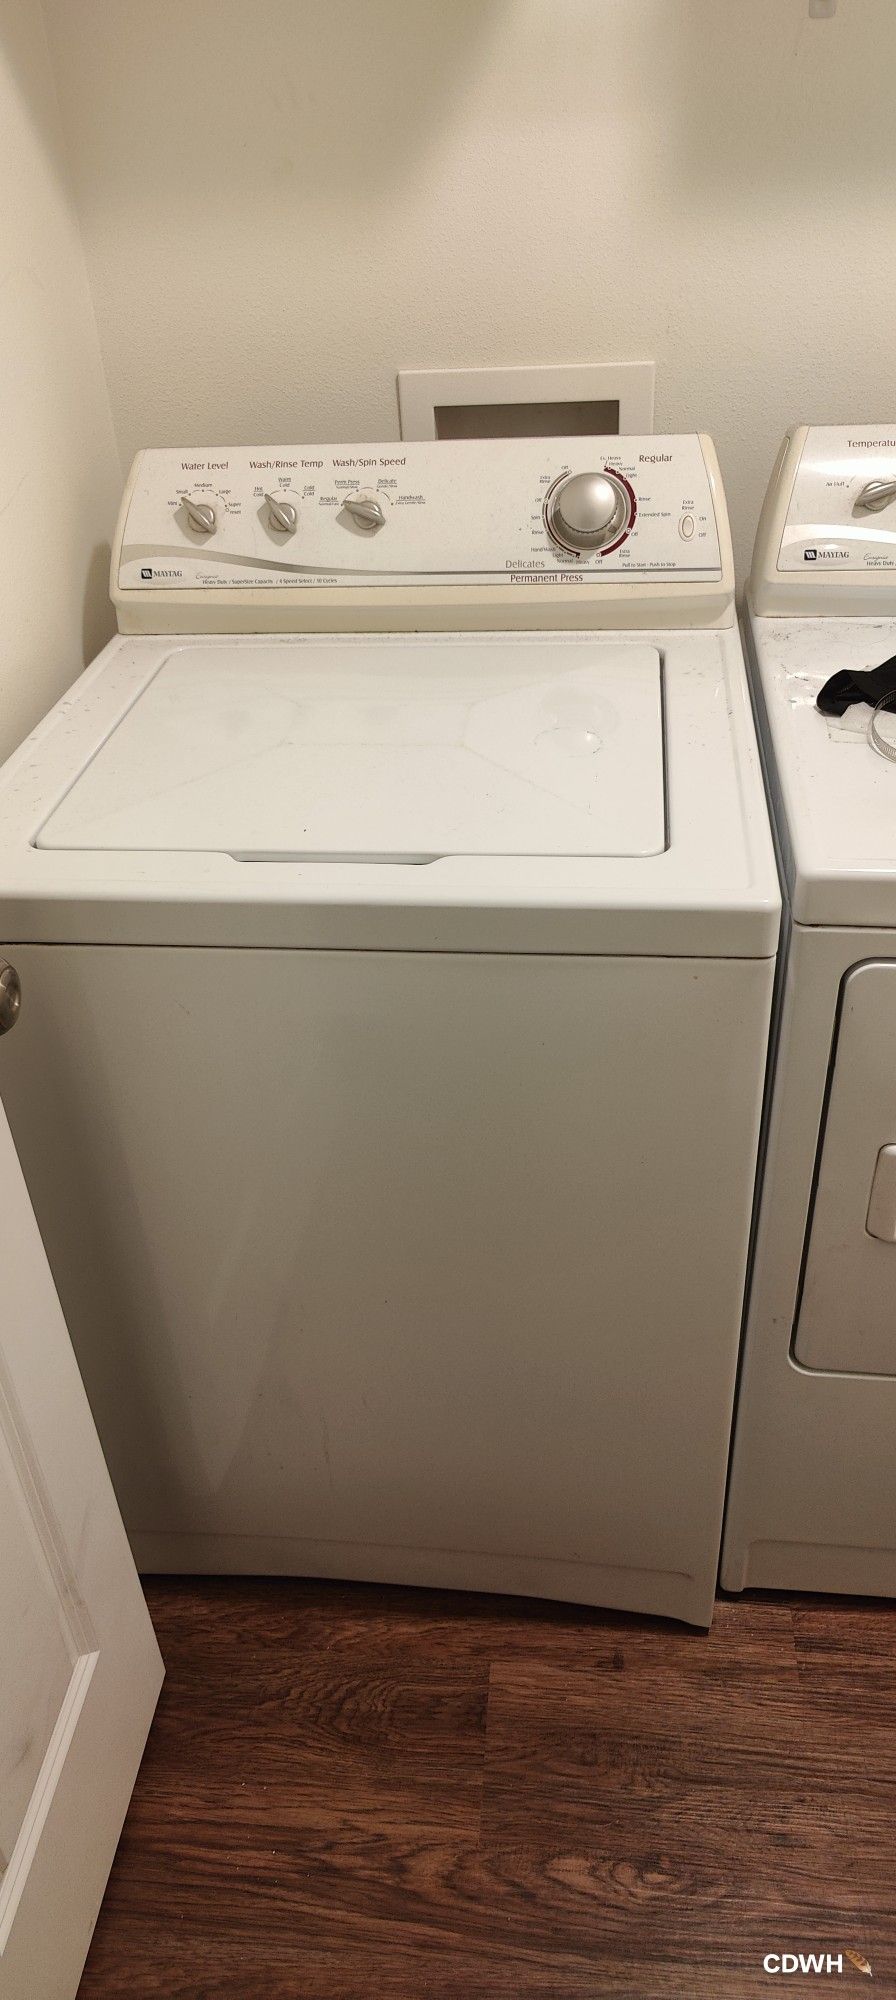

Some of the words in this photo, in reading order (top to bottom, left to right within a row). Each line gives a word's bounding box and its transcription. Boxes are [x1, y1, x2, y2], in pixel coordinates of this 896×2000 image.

[332, 458, 377, 467] Wash/Spin
[379, 457, 407, 466] Speed
[639, 454, 673, 464] Regular
[181, 461, 205, 470] Water
[207, 461, 229, 470] Level
[249, 460, 298, 469] Wash/Rinse
[300, 460, 324, 469] Temp
[818, 551, 850, 559] MAYTAG
[505, 559, 546, 569] Delicates
[153, 570, 183, 578] MAYTAG
[510, 574, 559, 583] Permanent
[560, 574, 584, 583] Press
